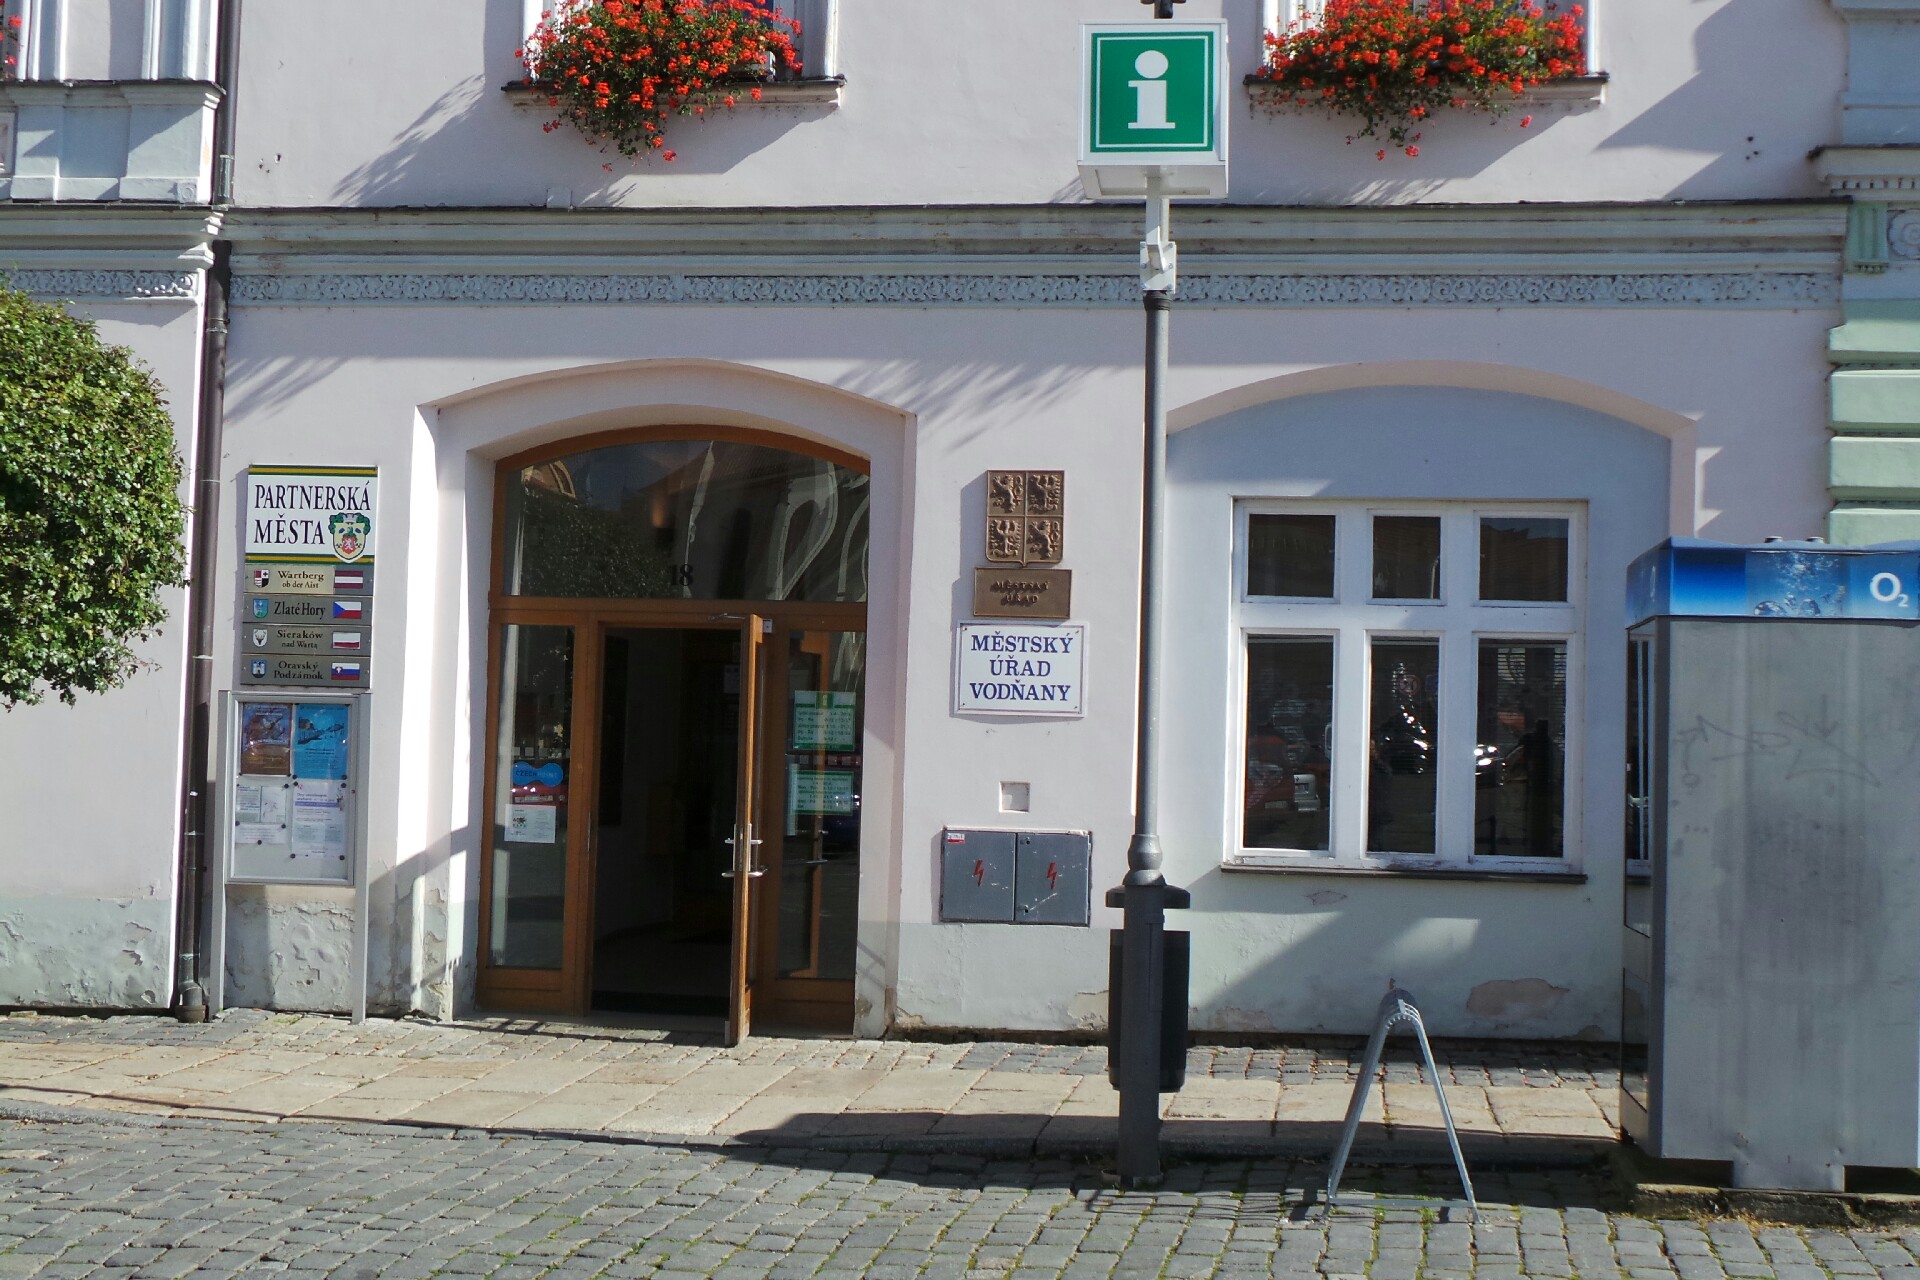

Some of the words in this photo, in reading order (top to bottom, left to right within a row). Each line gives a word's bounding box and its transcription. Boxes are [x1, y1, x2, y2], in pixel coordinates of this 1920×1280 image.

[254, 480, 371, 511] PARTNERSKÁ
[253, 513, 325, 545] MĚSTA
[278, 570, 325, 582] Wartberg
[671, 563, 694, 586] 18
[274, 601, 300, 615] Zlaté
[301, 602, 325, 620] Hory
[277, 629, 323, 639] Sieraków
[971, 631, 1073, 654] MĚSTSKÝ
[273, 670, 324, 680] Podzámok
[278, 660, 319, 671] Oravský
[989, 655, 1051, 677] ÚŘAD
[969, 678, 1071, 701] VODŇANY
